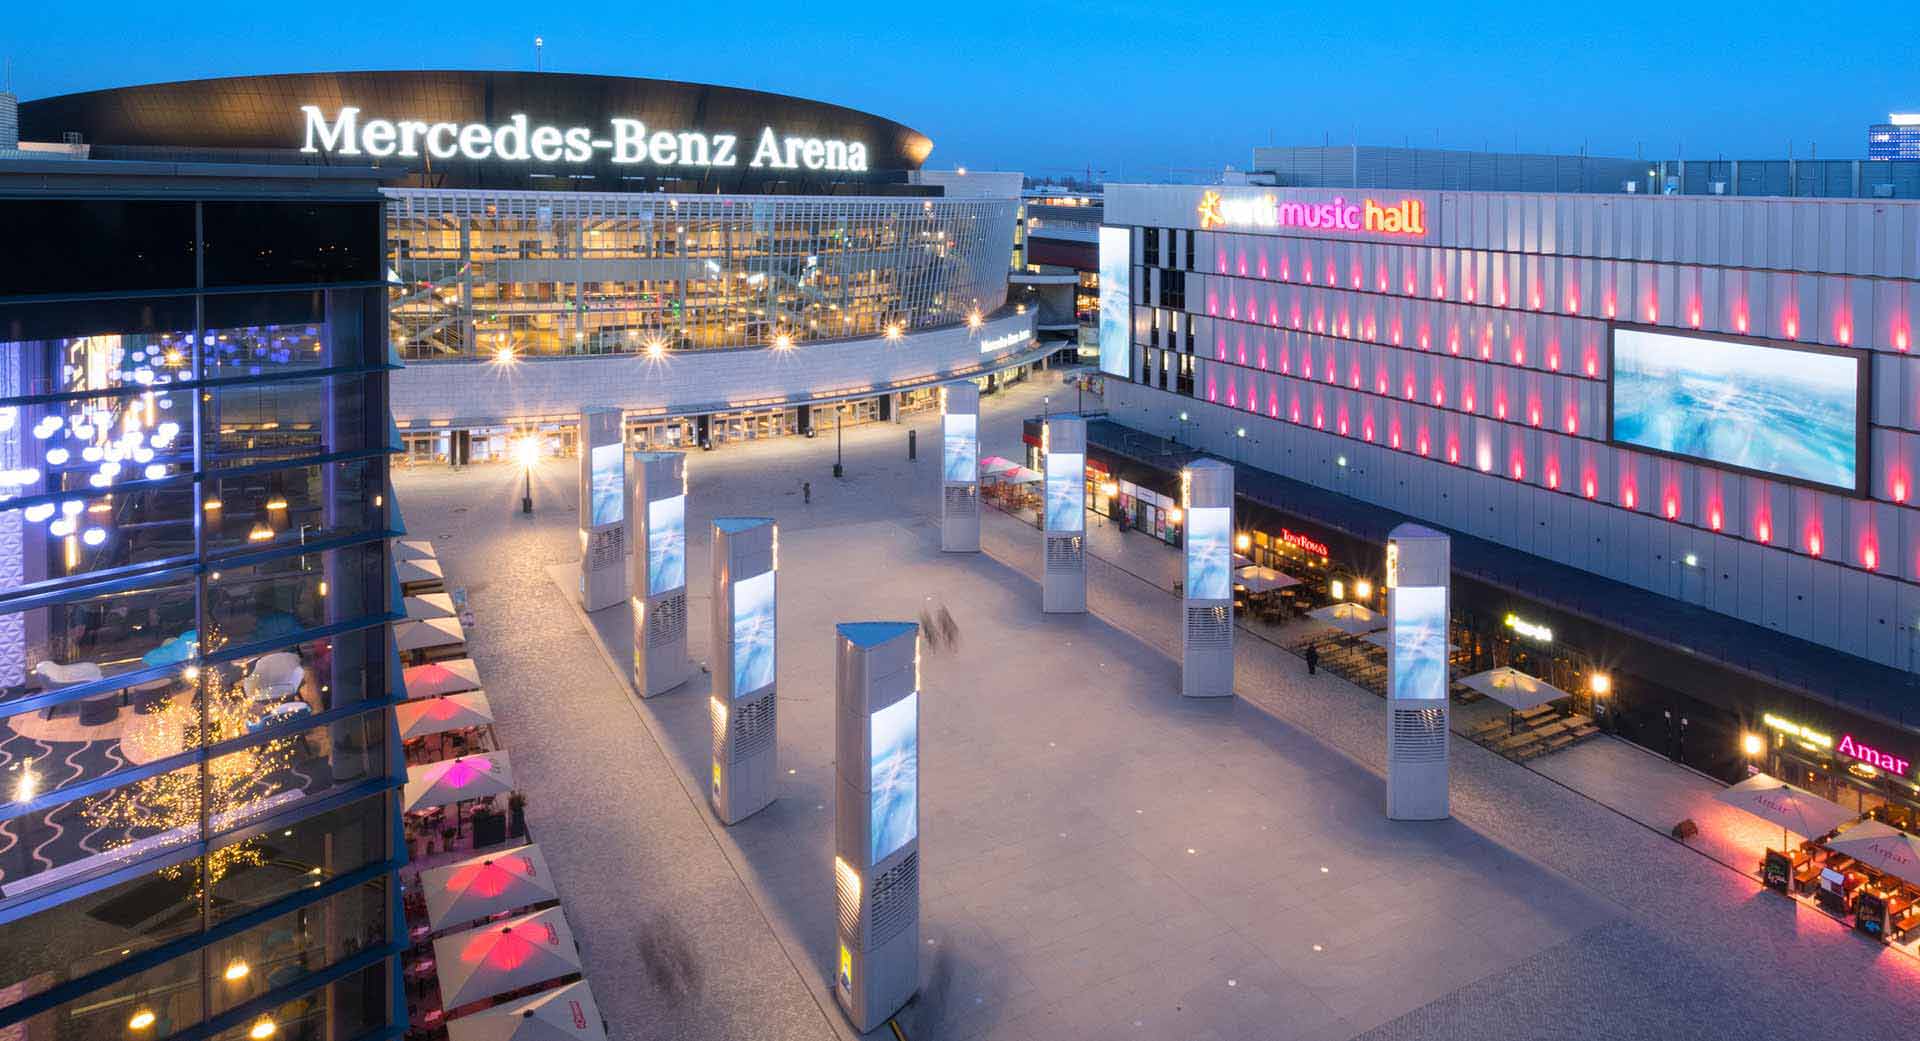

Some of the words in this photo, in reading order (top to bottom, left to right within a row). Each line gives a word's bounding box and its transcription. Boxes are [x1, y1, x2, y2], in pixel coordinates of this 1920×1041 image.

[300, 104, 737, 167] Mercedes-Benz
[749, 125, 868, 172] Arena
[1279, 196, 1361, 231] music
[1364, 198, 1425, 235] hall
[1838, 734, 1910, 776] Amar
[1866, 839, 1912, 865] Amar
